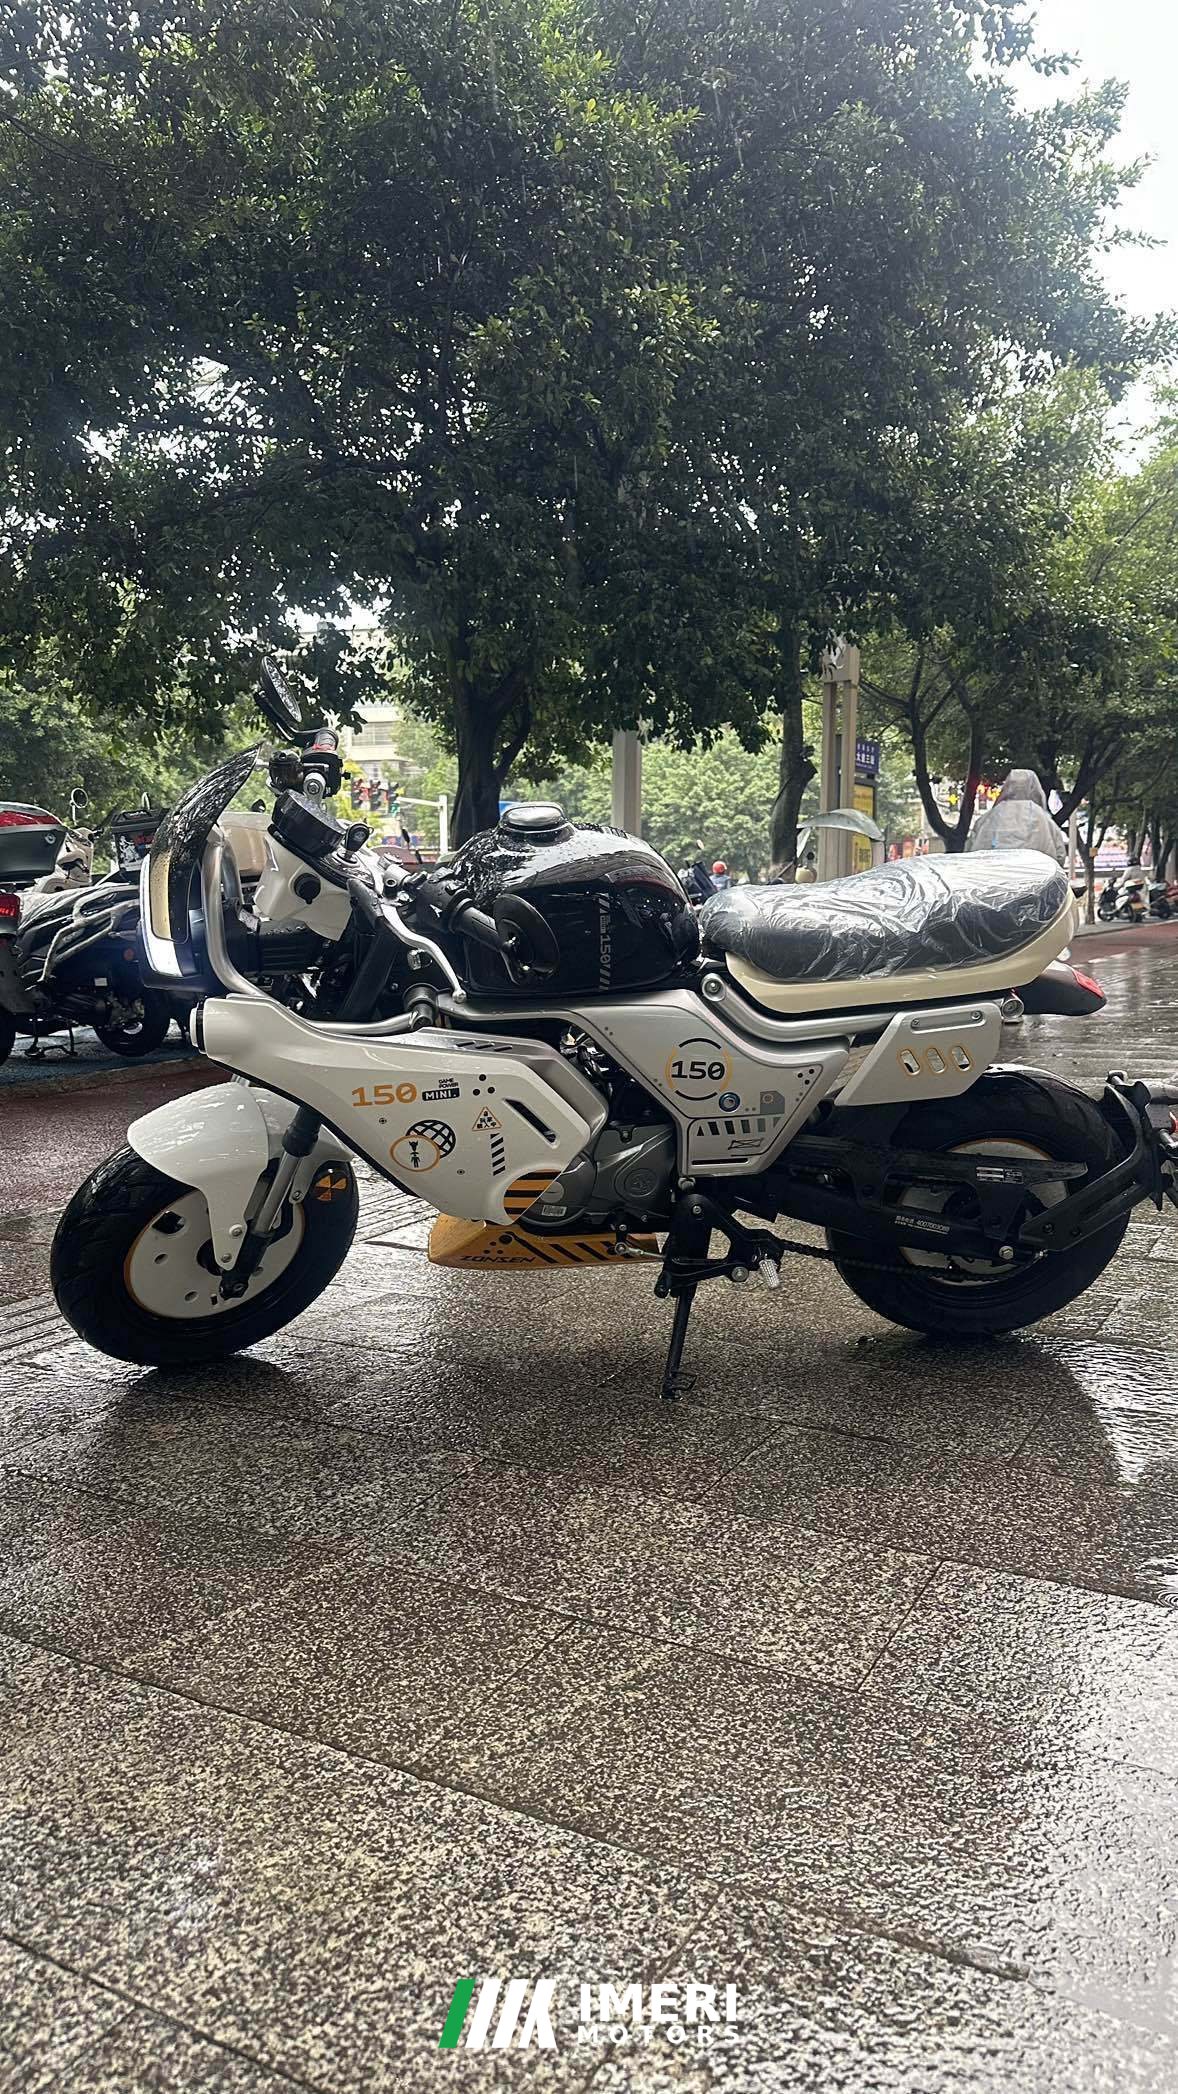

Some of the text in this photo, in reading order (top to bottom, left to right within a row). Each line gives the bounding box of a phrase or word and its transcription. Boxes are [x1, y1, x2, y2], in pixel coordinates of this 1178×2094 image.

[600, 934, 611, 964] 150
[671, 1060, 726, 1081] 150
[351, 1082, 417, 1107] 150
